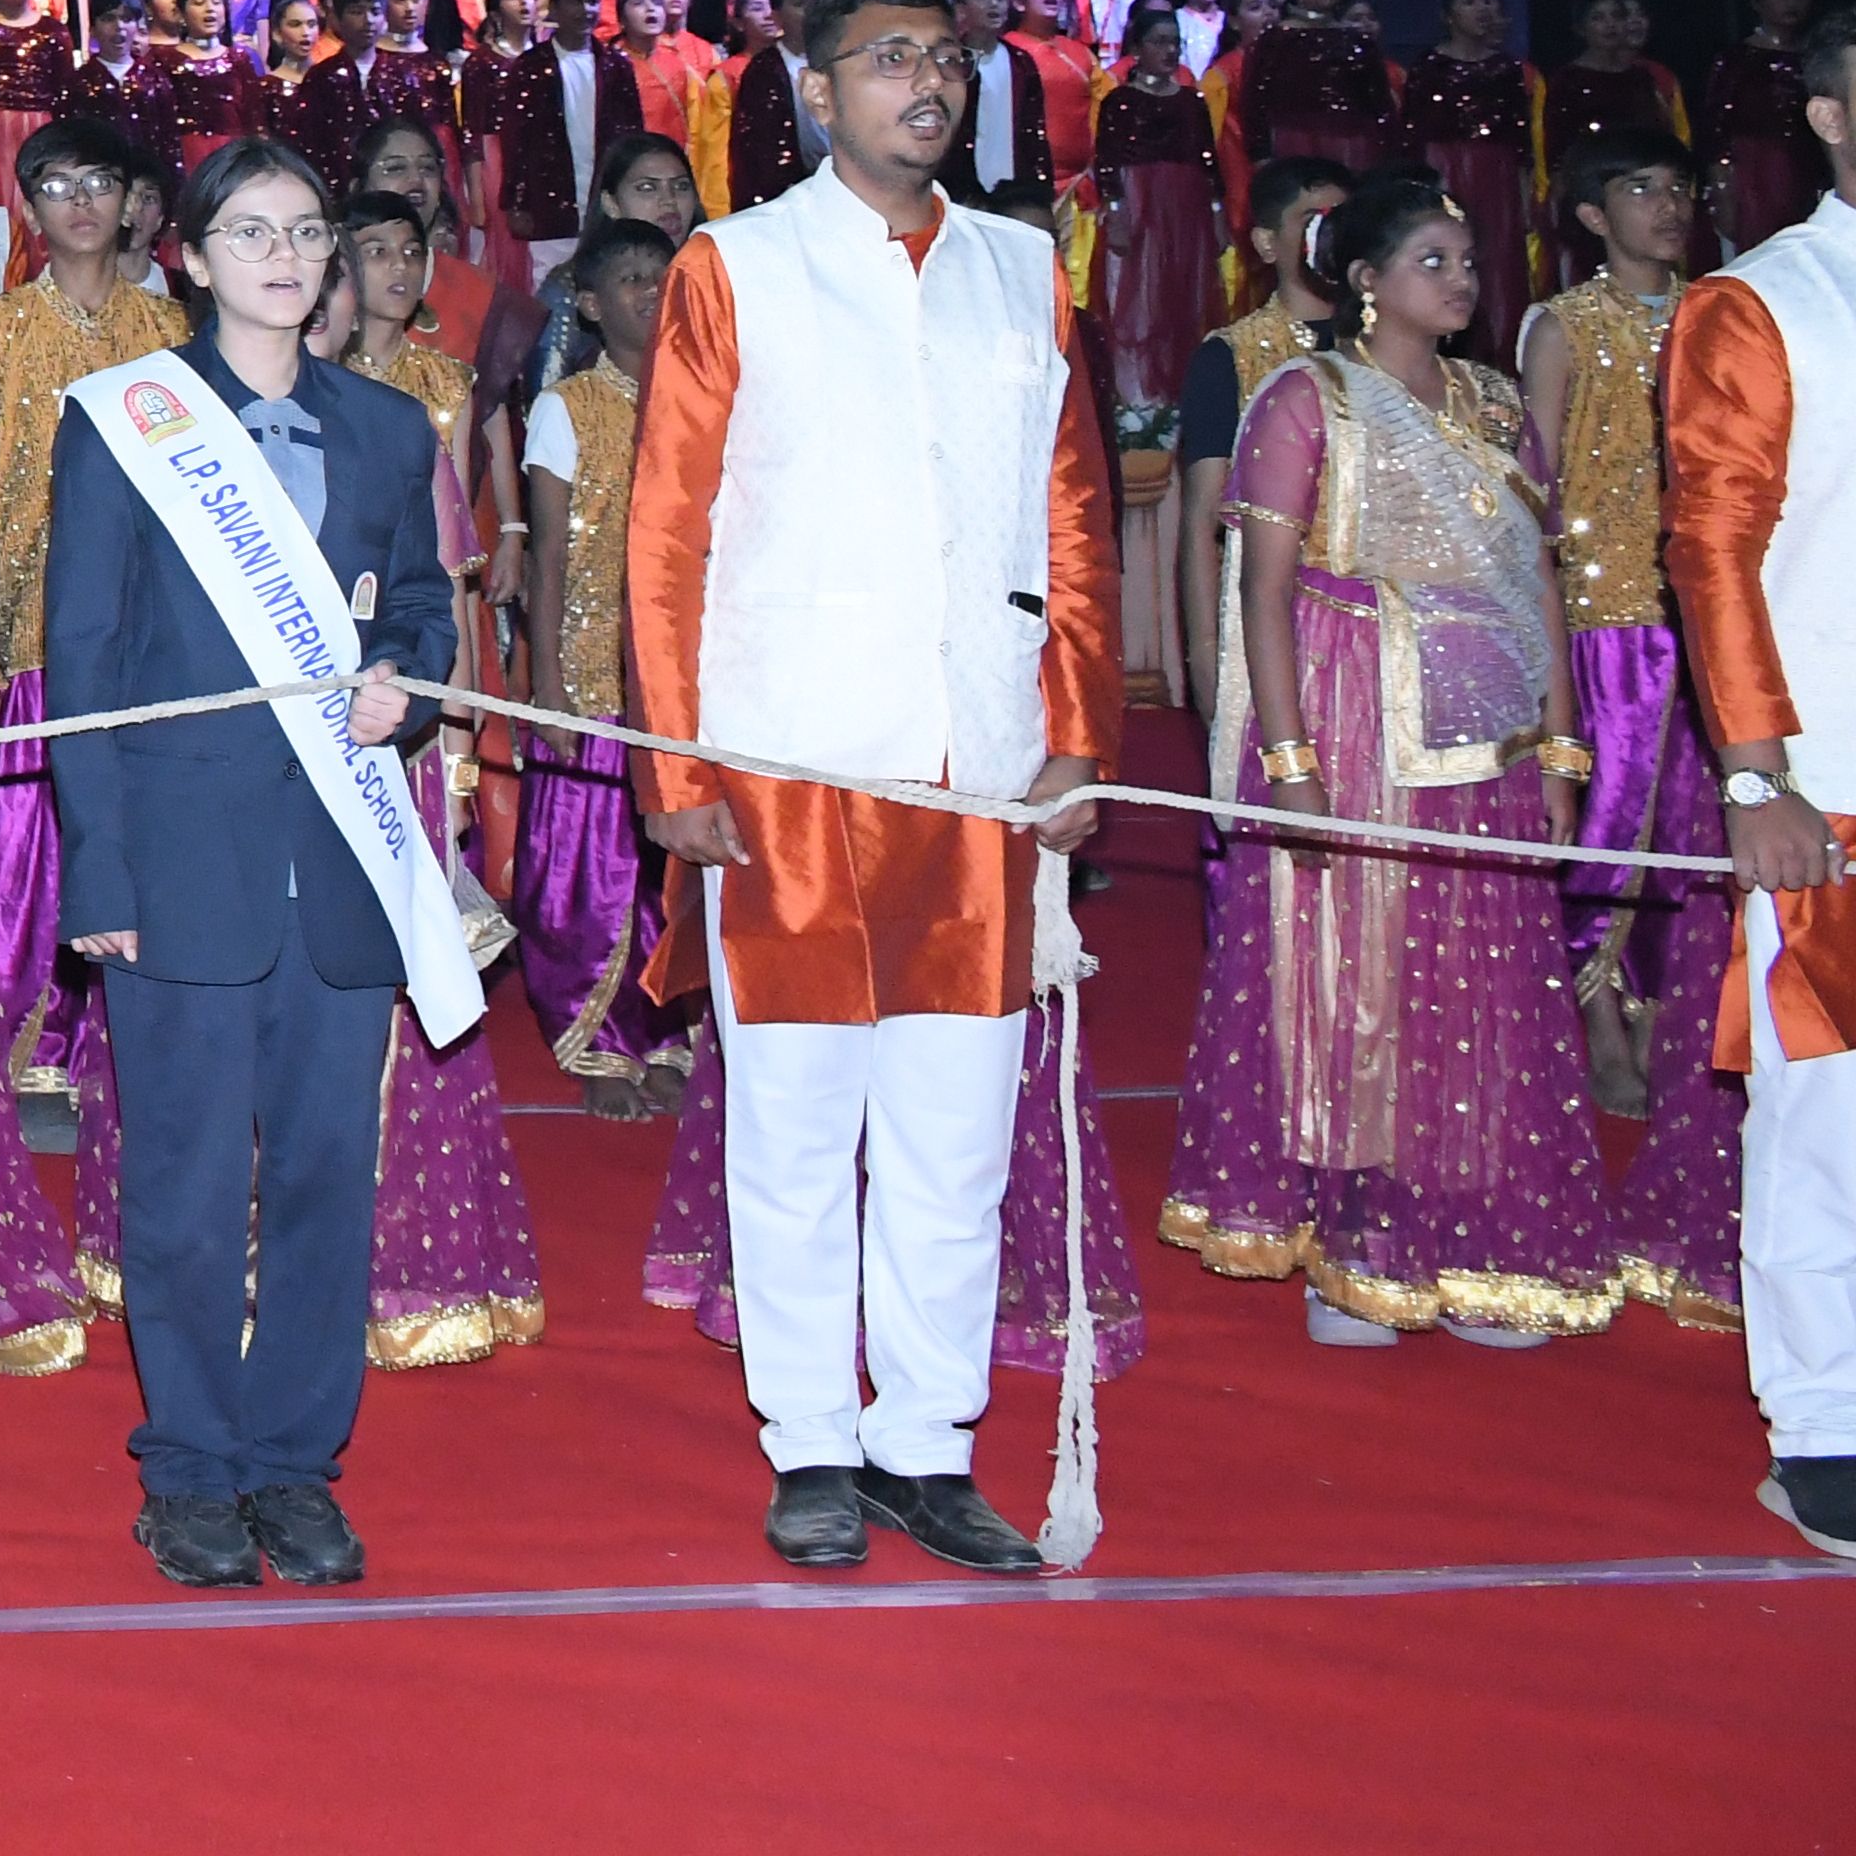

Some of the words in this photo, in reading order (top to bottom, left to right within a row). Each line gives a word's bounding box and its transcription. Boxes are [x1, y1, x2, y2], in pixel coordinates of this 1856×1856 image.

[200, 483, 281, 577] SAVANI
[252, 572, 363, 767] INTERNAIONAL
[355, 760, 409, 861] SCHOOL
